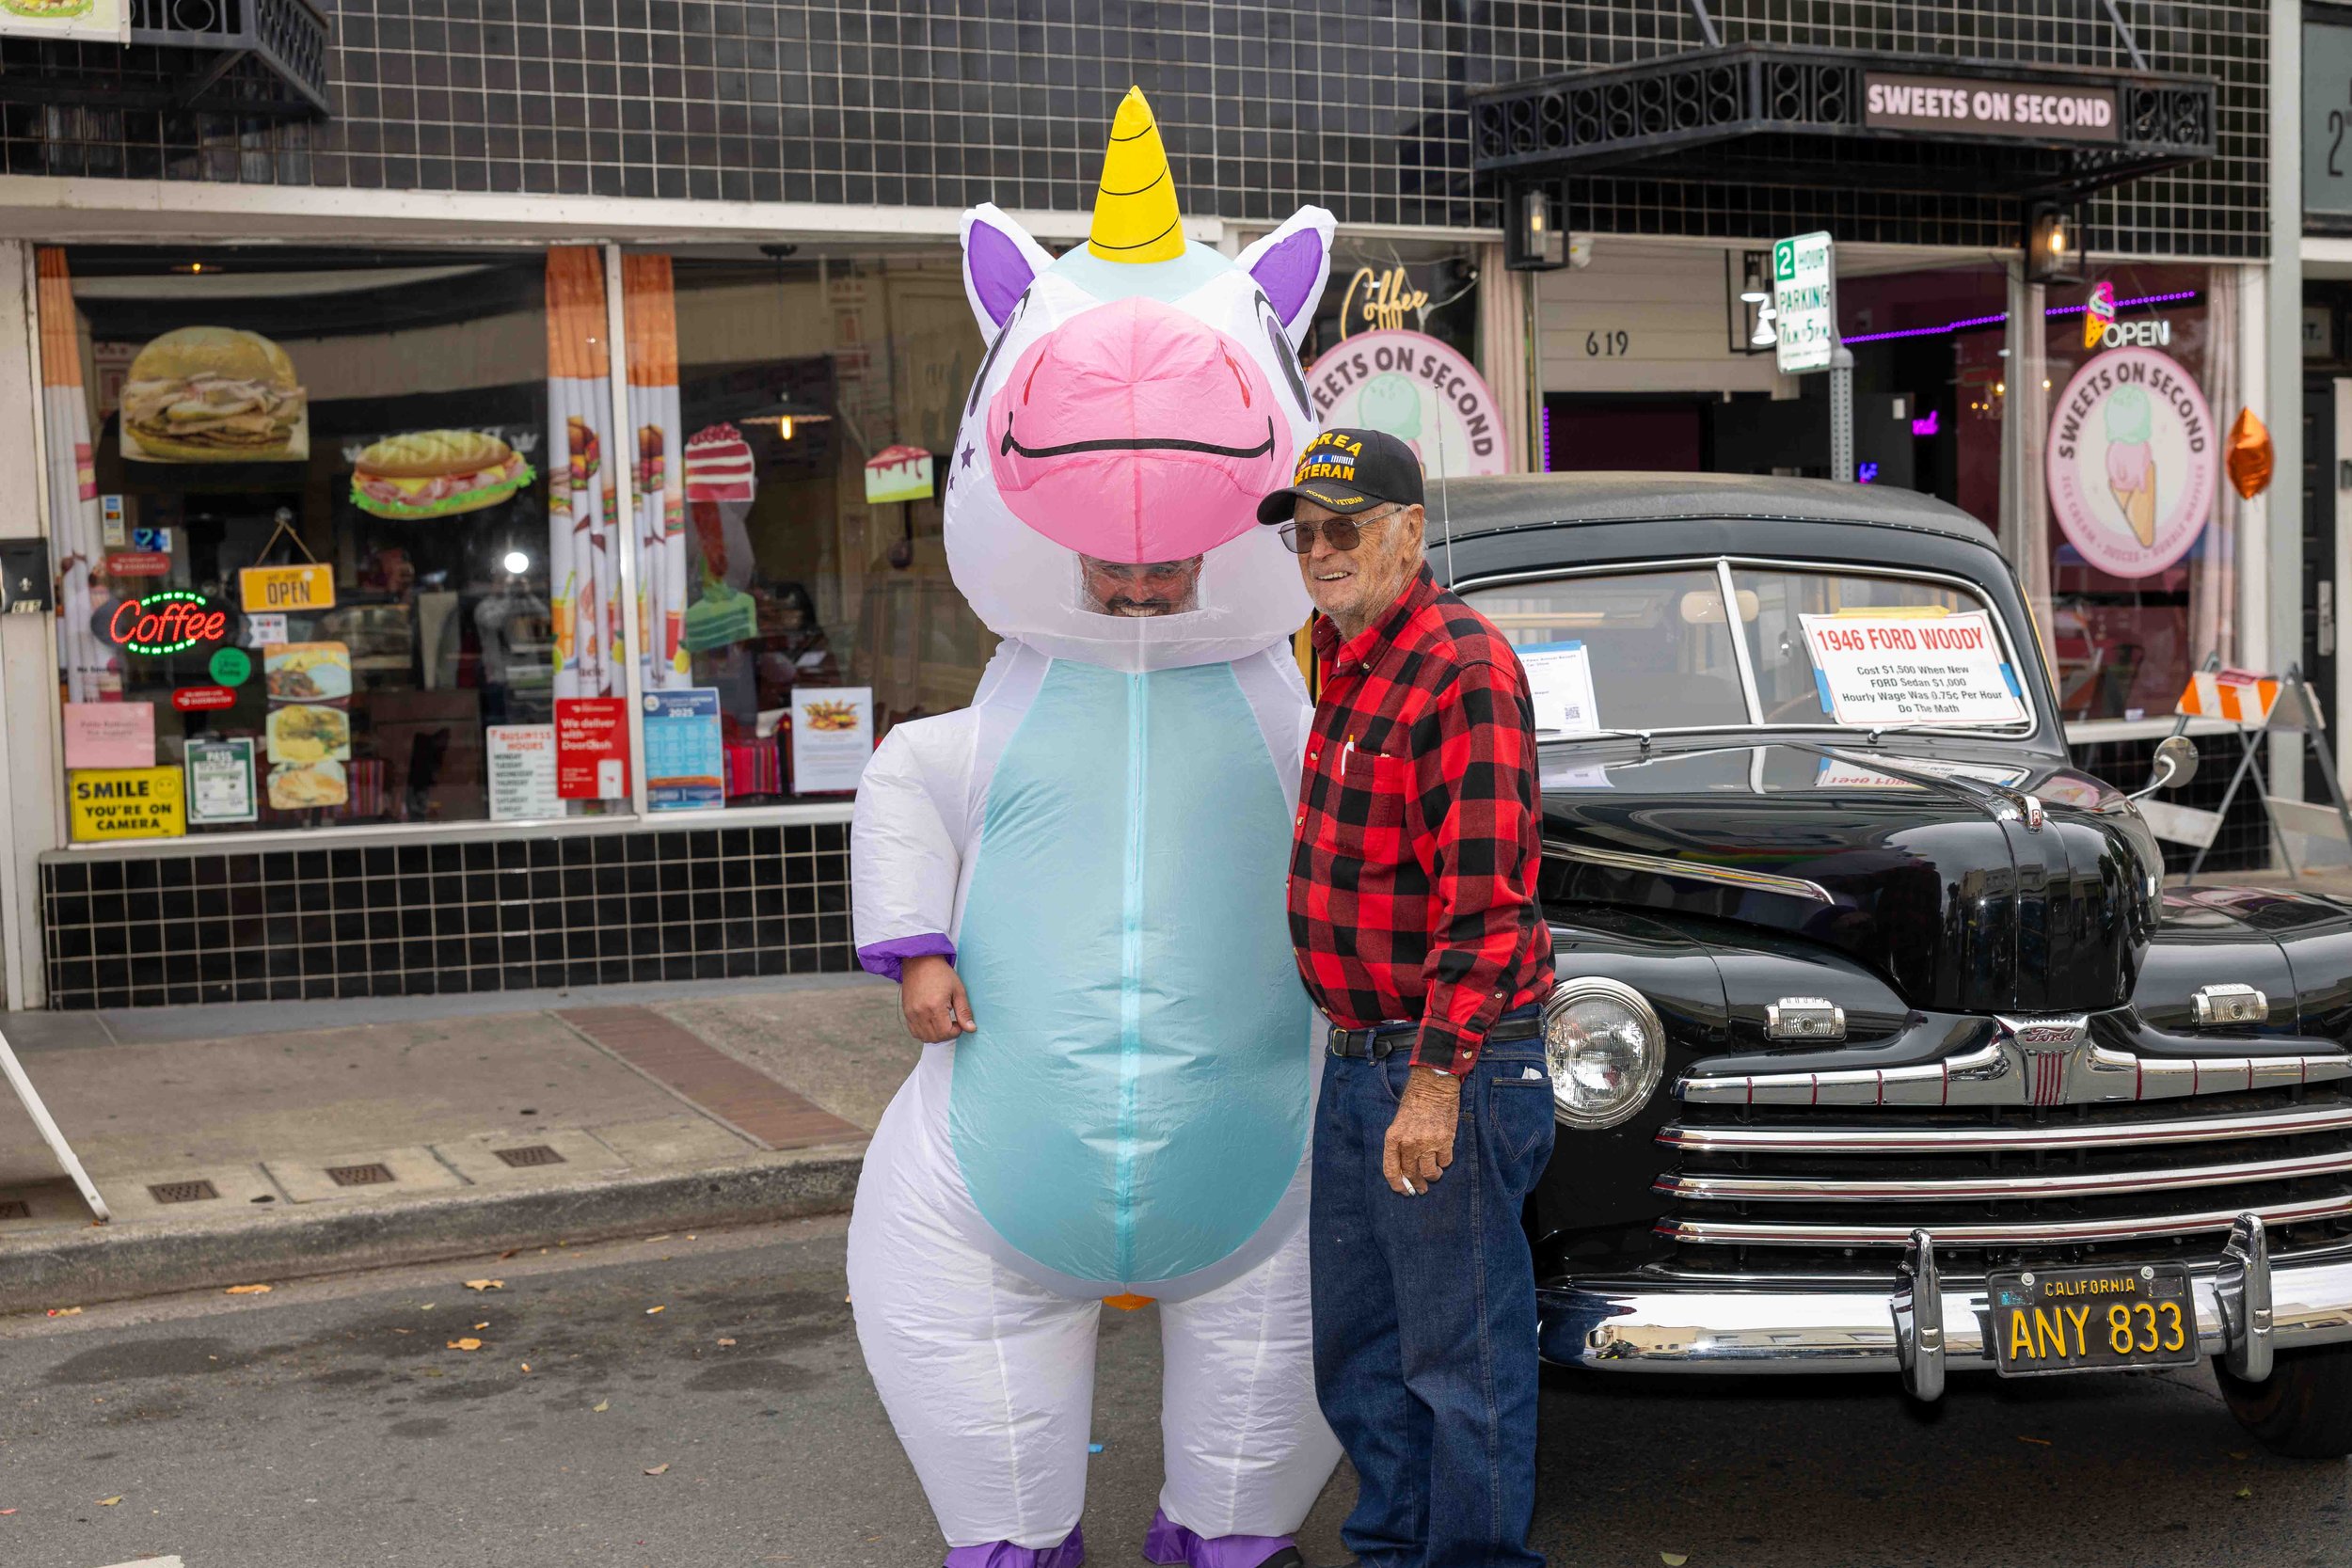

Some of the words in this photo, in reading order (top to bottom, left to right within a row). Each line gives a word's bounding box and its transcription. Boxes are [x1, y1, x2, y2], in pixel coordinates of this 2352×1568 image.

[1867, 84, 1969, 119] SWEETS
[1973, 91, 2010, 121] ON
[2014, 94, 2111, 127] SECOND
[1778, 245, 1792, 276] 2
[1341, 267, 1428, 341] Coffee
[1779, 285, 1829, 314] PARKING
[1585, 330, 1629, 356] 619
[2102, 321, 2170, 348] OPEN
[1312, 353, 1369, 423] EETS
[1375, 346, 1415, 372] ON
[1419, 355, 1494, 457] SECOND
[2058, 370, 2111, 459] SWEETS
[2117, 362, 2146, 383] ON
[2149, 368, 2205, 453] SECOND
[1306, 489, 1334, 504] KOREA
[1334, 496, 1365, 506] VETERAN
[266, 580, 311, 605] OPEN
[110, 599, 226, 643] Coffee
[1817, 629, 1866, 651] 1946
[1867, 627, 1916, 650] FORD
[1918, 626, 1984, 650] WOODY
[1857, 666, 1880, 675] Cost
[1882, 665, 1916, 676] $1,500
[1918, 666, 1946, 674] When
[1947, 665, 1969, 674] New
[1870, 678, 1898, 688] FORD
[1900, 677, 1931, 687] Sedan
[1932, 677, 1966, 688] $1,000
[1842, 692, 1876, 703] Hourly
[1878, 691, 1906, 702] Wage
[1908, 690, 1930, 700] Was
[1962, 690, 1978, 700] Per
[1979, 690, 2003, 700] Hour
[1899, 705, 1913, 713] Do
[1914, 704, 1932, 713] The
[1934, 704, 1960, 713] Math
[561, 718, 580, 729] We
[580, 718, 616, 729] deliver
[561, 729, 585, 739] with
[561, 739, 613, 751] DoorDash
[77, 780, 151, 800] SMILE
[85, 804, 142, 817] YOU'RE
[149, 803, 172, 816] ON
[96, 818, 161, 832] CAMERA
[2026, 1026, 2078, 1043] Ford
[2044, 1278, 2136, 1297] CALIFORNIA
[2010, 1305, 2090, 1360] ANY
[2108, 1301, 2185, 1354] 833
